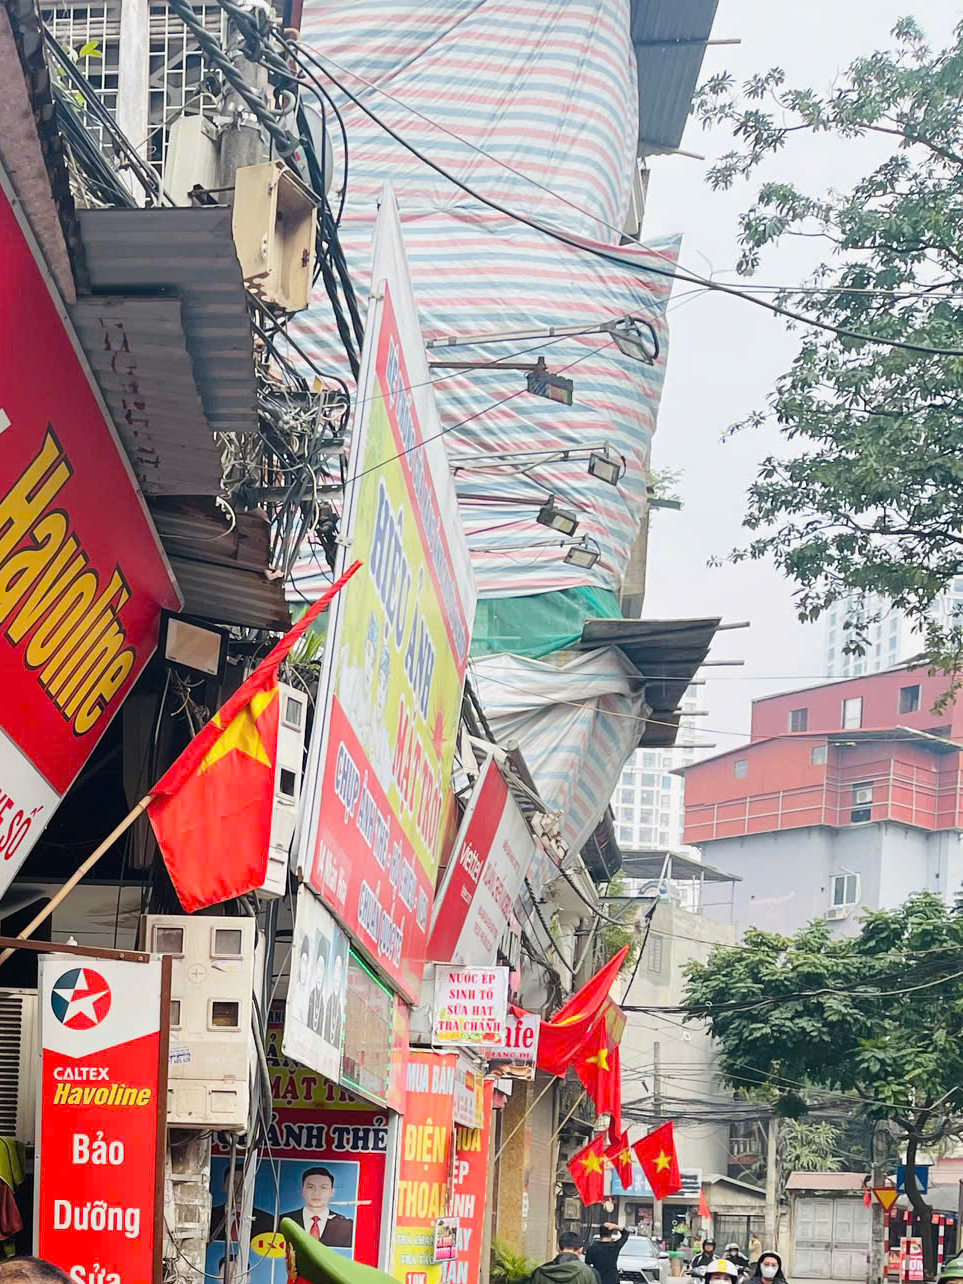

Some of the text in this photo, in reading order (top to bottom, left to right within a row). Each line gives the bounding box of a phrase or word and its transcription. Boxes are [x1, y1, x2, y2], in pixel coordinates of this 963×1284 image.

[448, 989, 476, 1000] SINH
[53, 1067, 110, 1081] CALTEX
[407, 1059, 455, 1095] MUA BÁN
[53, 1083, 152, 1106] Havoline
[72, 1131, 125, 1165] Bảo
[332, 1117, 389, 1151] THẺ
[405, 1117, 446, 1171] ĐIỆN
[53, 1199, 141, 1239] Dưỡng
